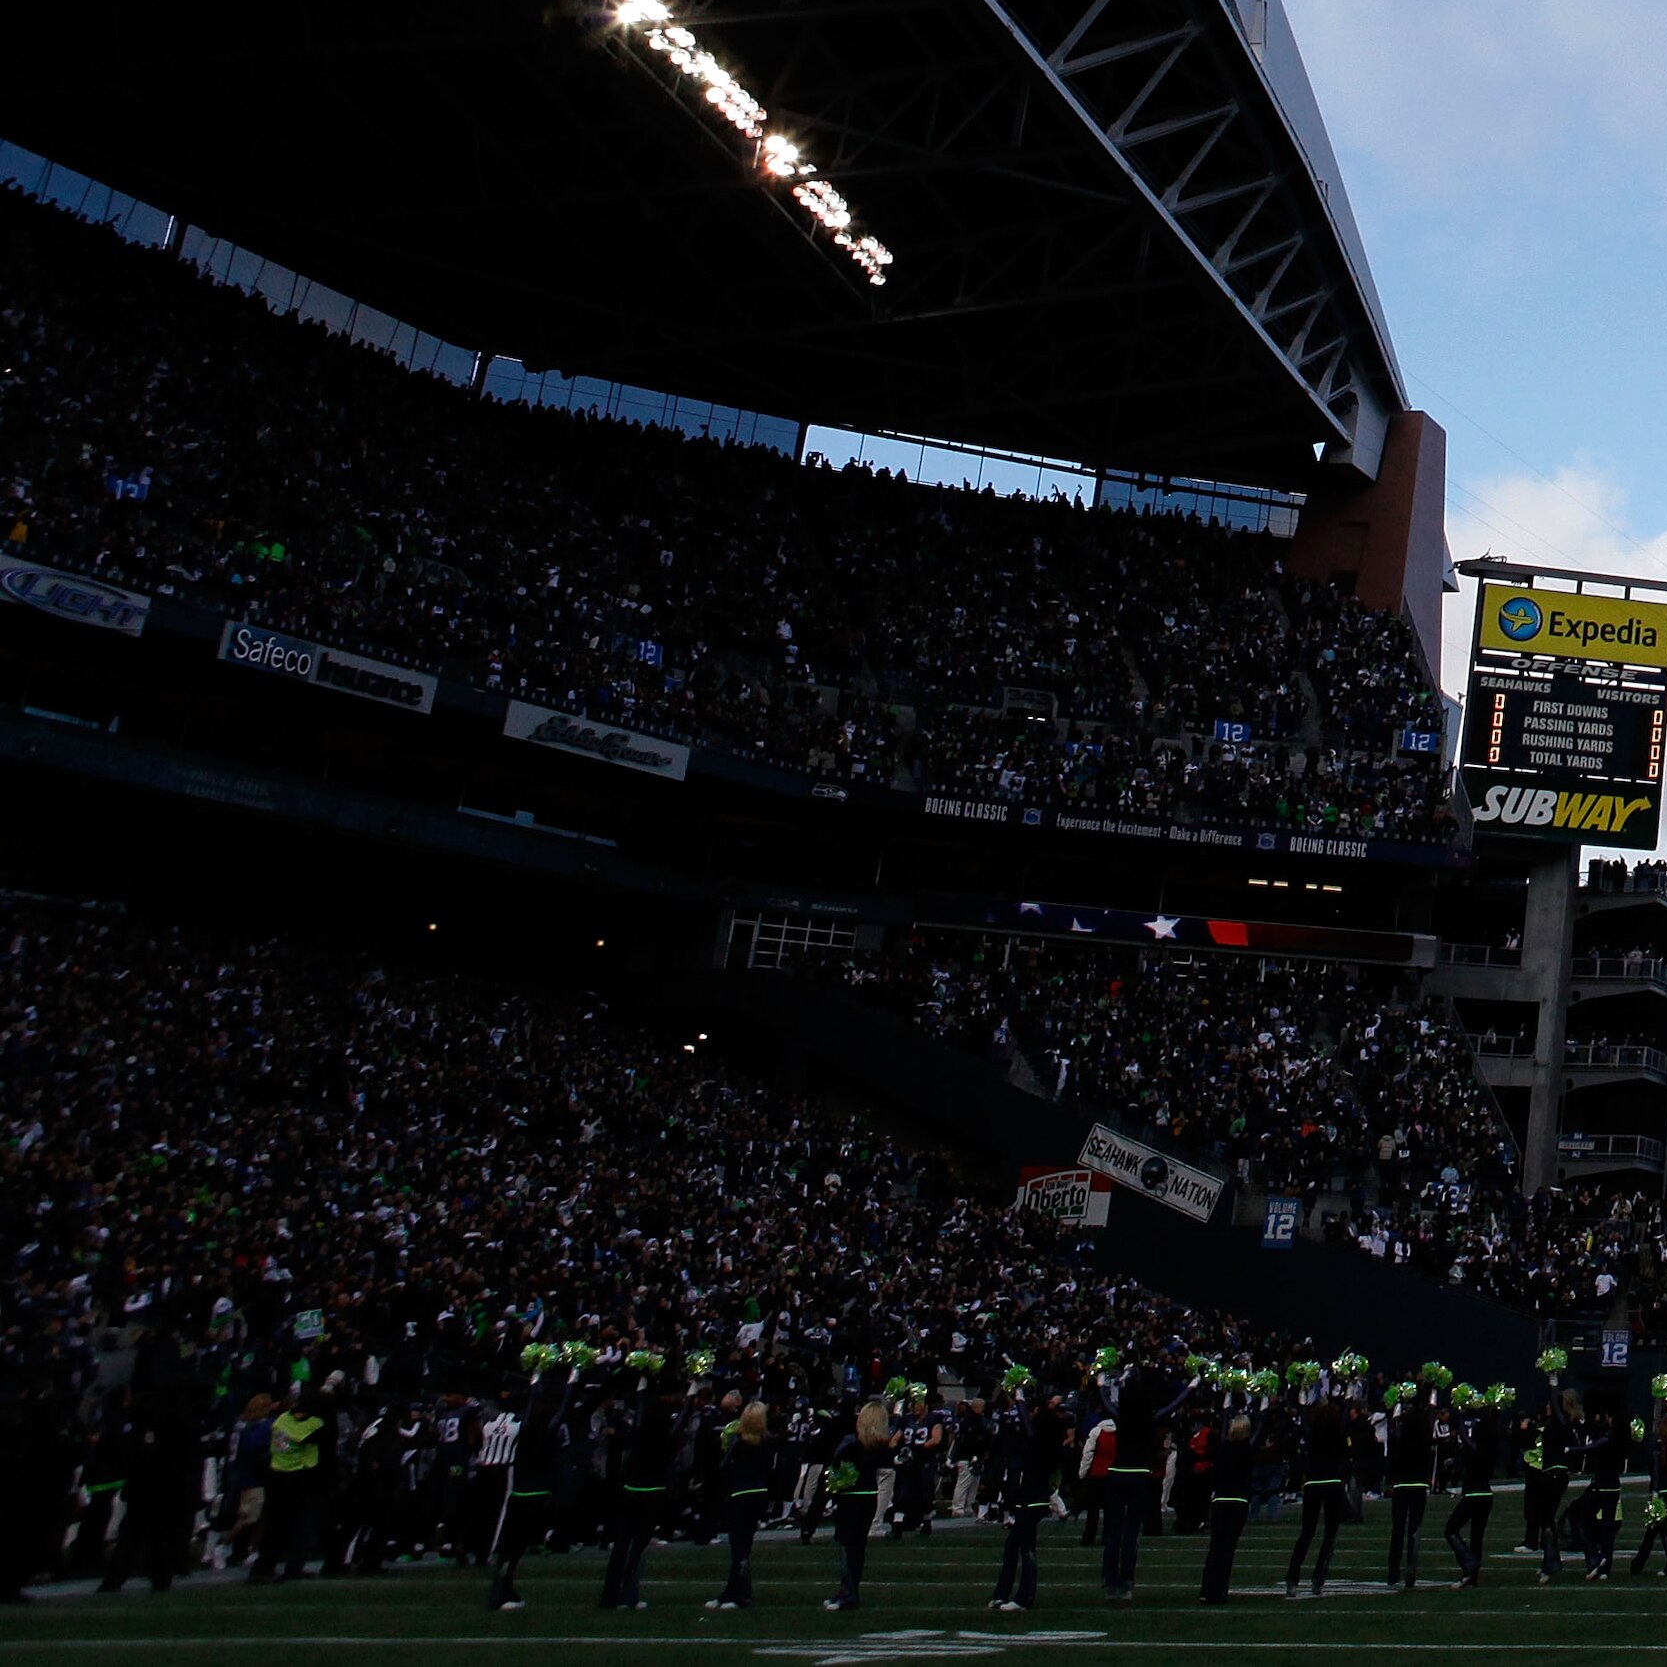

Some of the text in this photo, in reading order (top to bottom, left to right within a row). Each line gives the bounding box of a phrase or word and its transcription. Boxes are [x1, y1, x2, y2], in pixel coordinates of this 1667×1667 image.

[1549, 611, 1658, 647] Expedia
[233, 628, 312, 675] Safeco
[1511, 658, 1637, 681] OFFENSE
[1480, 676, 1661, 704] SEAHAWKS VISITORS
[1494, 693, 1505, 710] 0
[1533, 700, 1608, 719] FIRST DOWNS
[1492, 711, 1503, 727] 0
[1524, 716, 1613, 737] PASSING YARDS
[1653, 710, 1663, 725] 0
[1222, 722, 1244, 742] 12
[1410, 732, 1430, 752] 12
[1490, 728, 1502, 745] 0
[1651, 728, 1661, 743] 0
[1522, 734, 1613, 753] RUSHING YARDS
[1650, 745, 1660, 760] 0
[1488, 746, 1500, 763] 0
[1530, 750, 1604, 770] TOTAL YARDS
[1648, 762, 1658, 778] 0
[925, 797, 1009, 822] BOEING CLASSIC
[1473, 785, 1652, 832] SUBWAY
[1056, 813, 1101, 832] Experience
[1103, 816, 1116, 833] the
[1117, 816, 1162, 838] Excitement
[1169, 825, 1191, 842] Make
[1200, 829, 1243, 847] Difference
[1289, 836, 1368, 858] BOEING CLASSIC
[1086, 1136, 1218, 1210] SEAHAWK NATION
[1269, 1201, 1297, 1214] VOLUME
[1263, 1214, 1295, 1240] 12
[1601, 1343, 1628, 1365] 12
